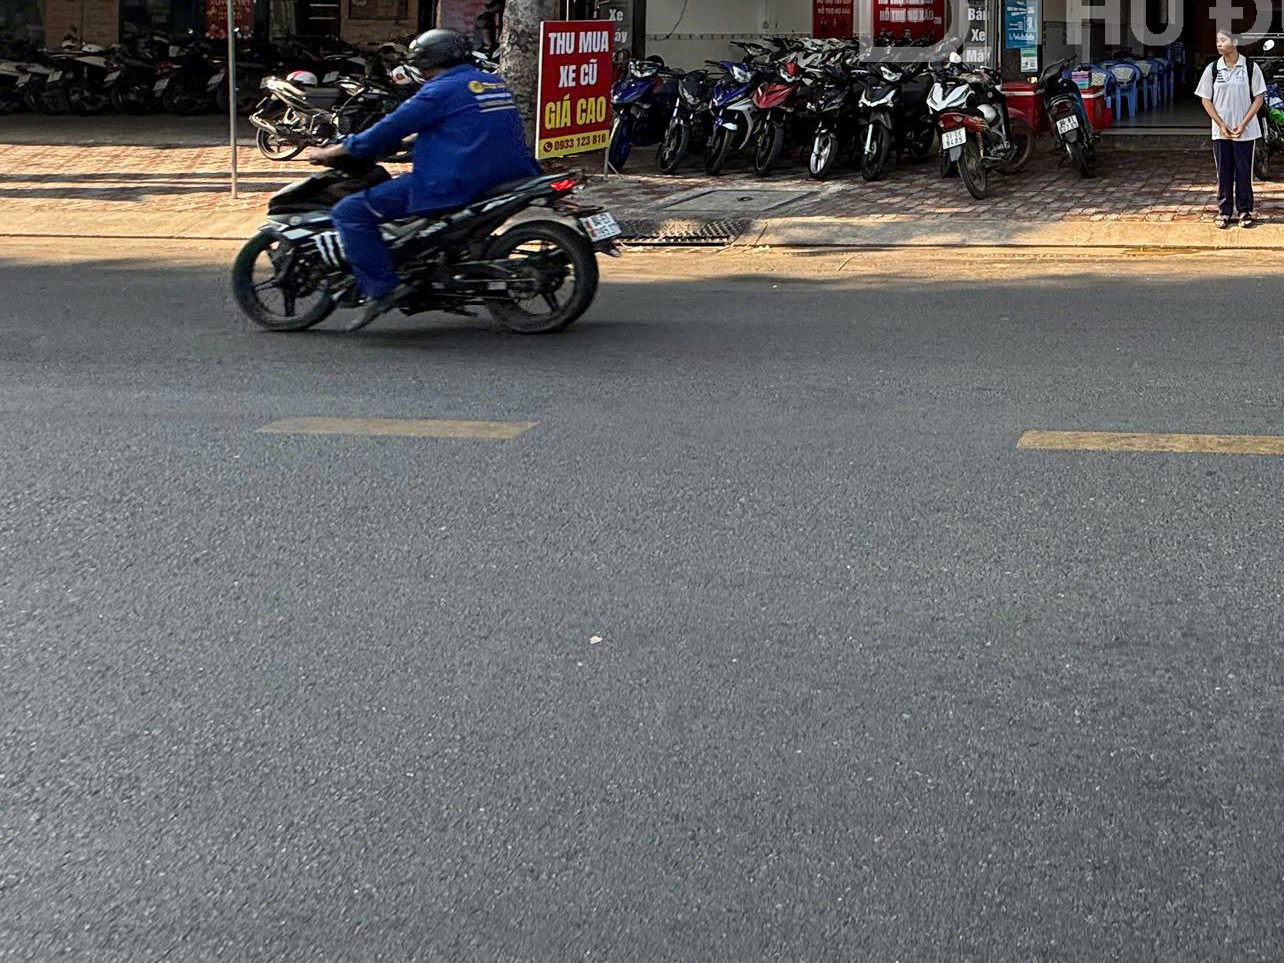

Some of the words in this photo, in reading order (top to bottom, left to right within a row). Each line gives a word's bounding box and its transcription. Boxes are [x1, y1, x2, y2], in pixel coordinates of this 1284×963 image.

[548, 31, 576, 55] THU
[578, 30, 610, 54] MUA
[558, 64, 577, 88] XE
[579, 58, 598, 86] CŨ
[544, 93, 572, 131] GIÁ
[576, 95, 607, 126] CAO
[554, 138, 574, 151] 0933
[576, 135, 591, 147] 123
